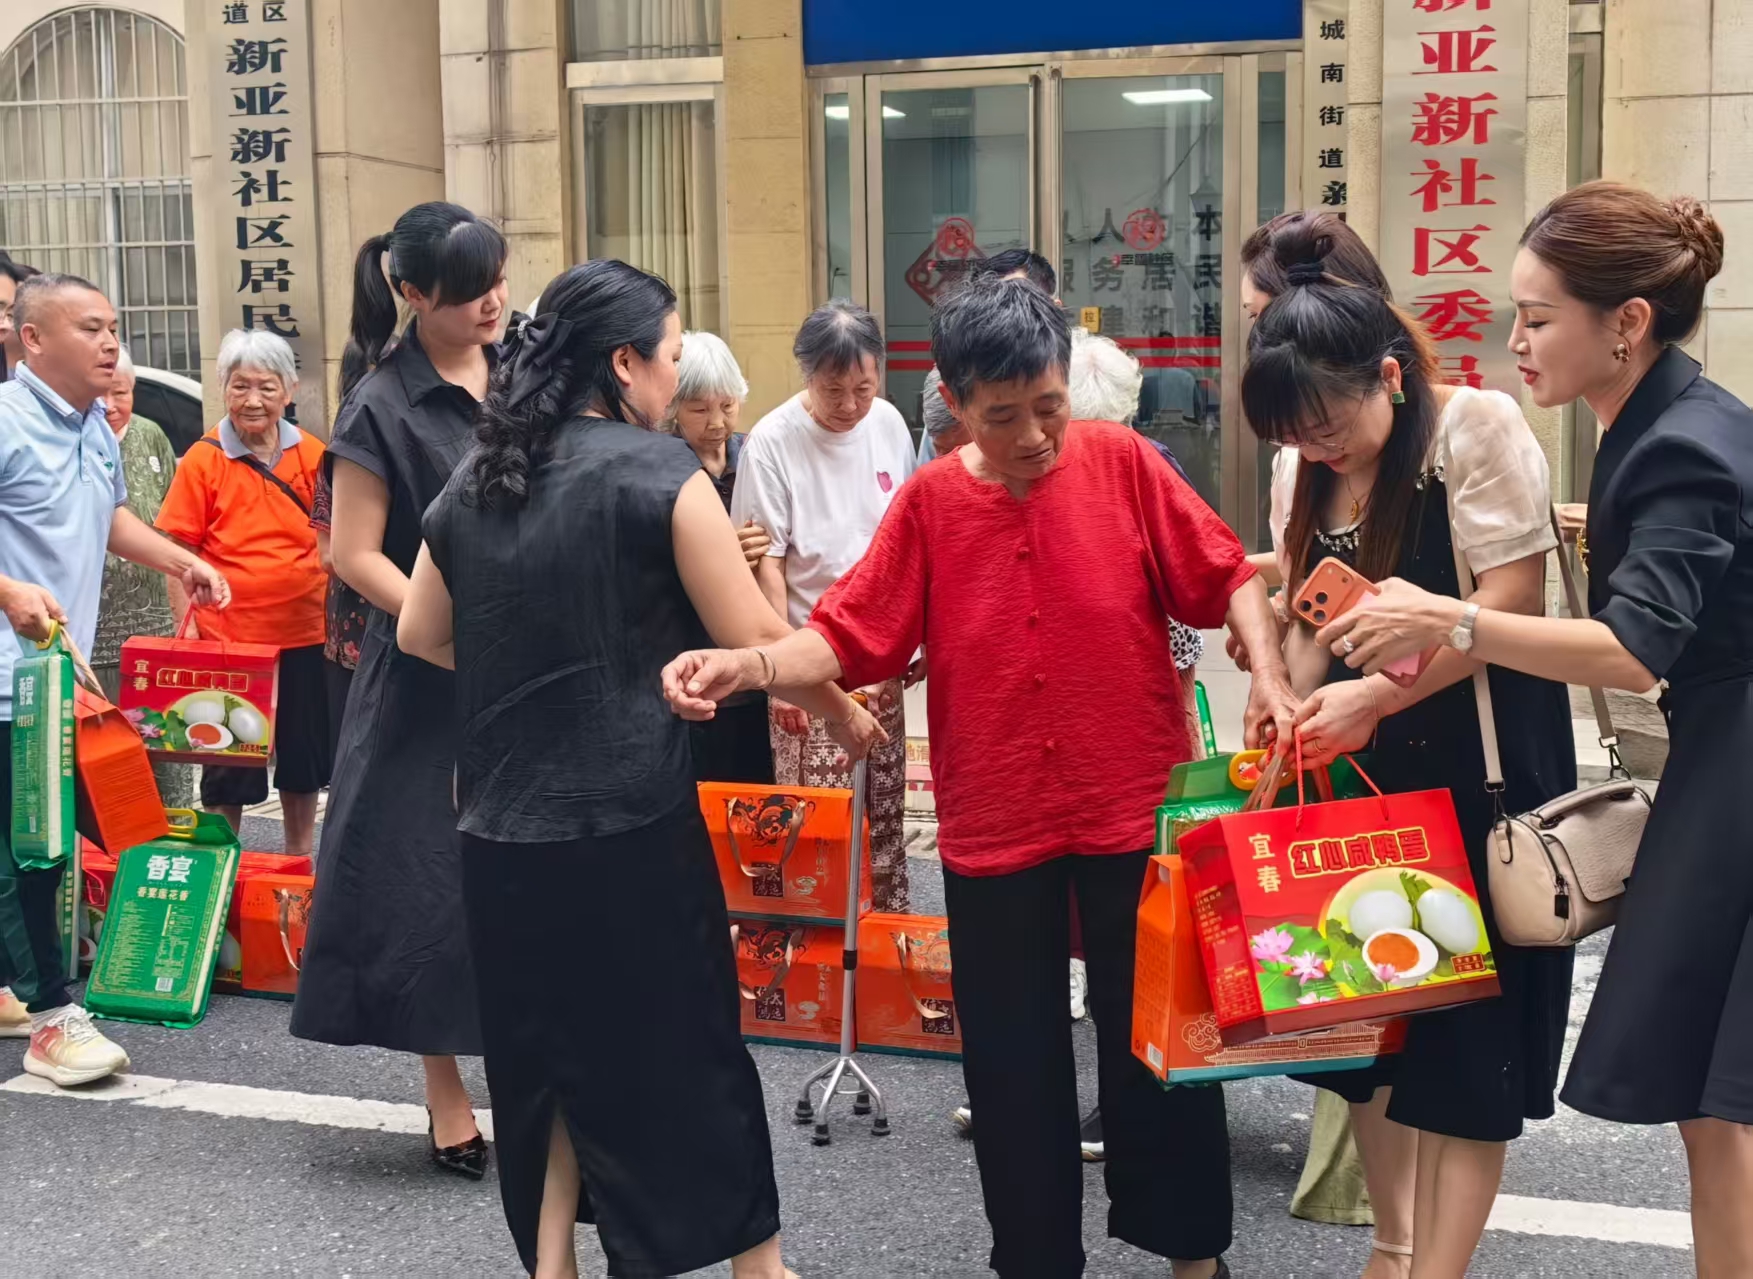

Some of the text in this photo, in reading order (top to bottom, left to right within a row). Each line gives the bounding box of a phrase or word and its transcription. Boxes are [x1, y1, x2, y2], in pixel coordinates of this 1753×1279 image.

[1319, 20, 1345, 168] 城南街道
[225, 37, 301, 424] 新亚新社区居民
[1410, 0, 1498, 390] 亚新社区委
[132, 659, 149, 691] 宜春
[146, 854, 193, 883] 香宴
[1248, 832, 1281, 893] 宜春
